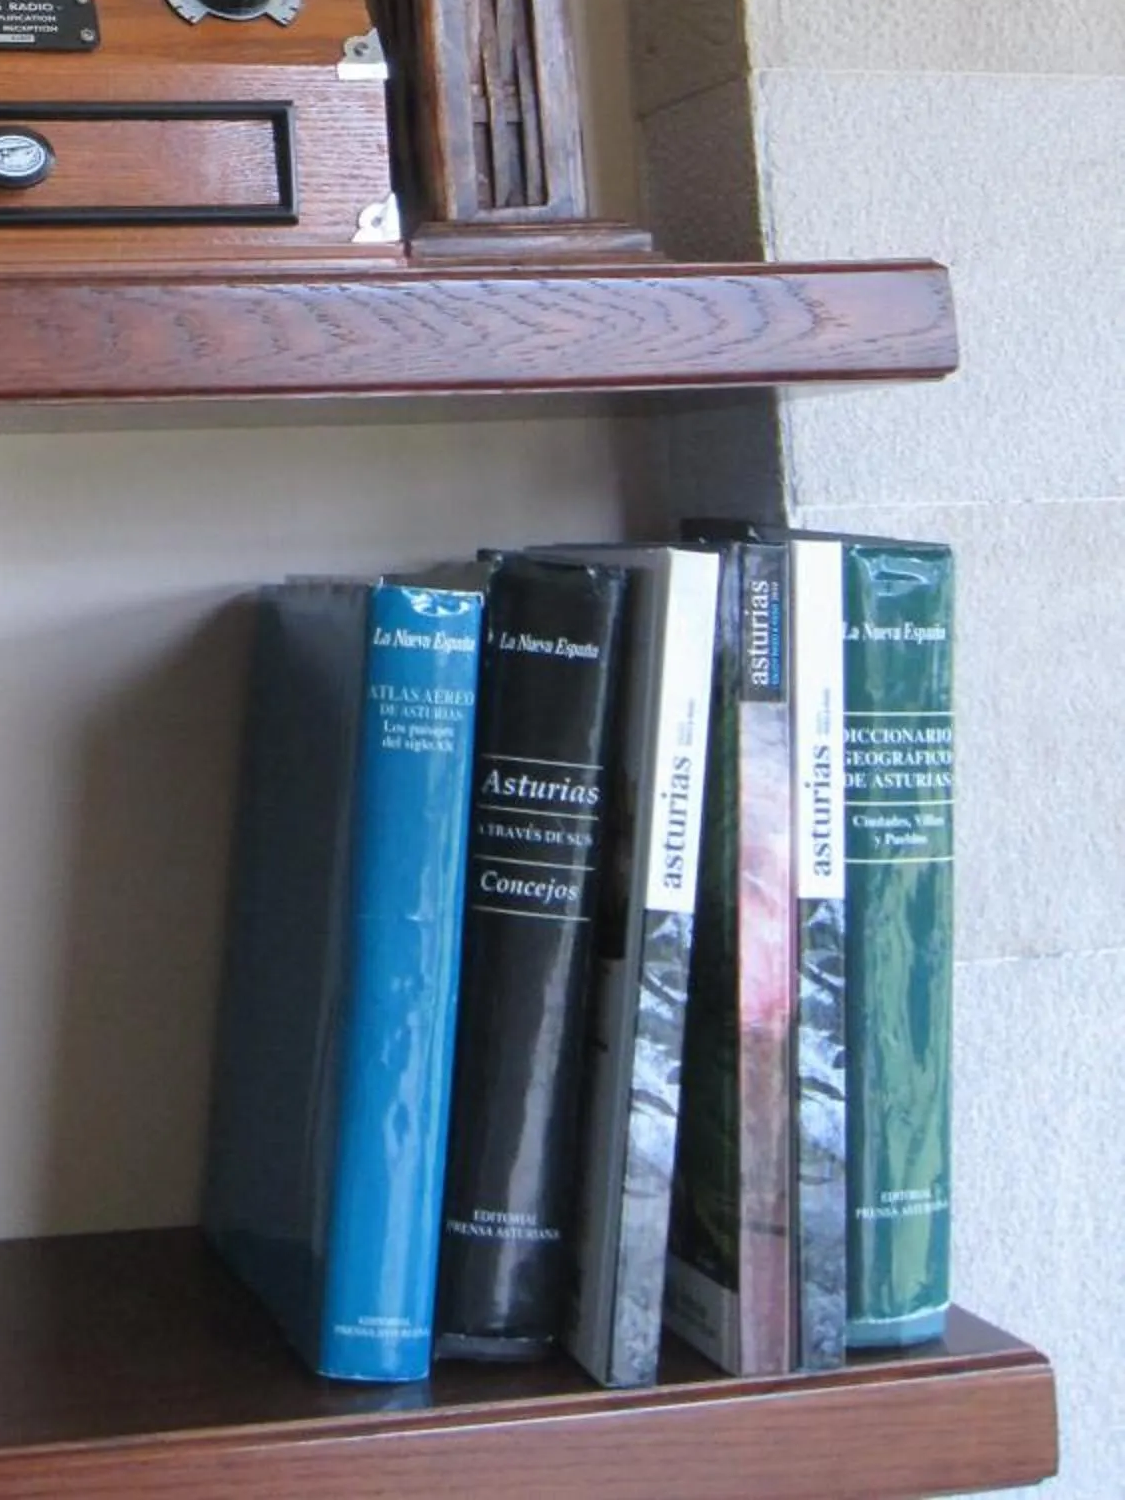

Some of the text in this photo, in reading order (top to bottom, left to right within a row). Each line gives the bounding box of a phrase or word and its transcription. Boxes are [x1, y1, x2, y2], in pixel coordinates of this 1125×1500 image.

[8, 2, 55, 11] RADIO
[373, 627, 476, 655] La Nueva España
[498, 631, 600, 659] La Nueva España
[744, 580, 770, 686] asturias
[843, 621, 946, 645] La Nueva España
[368, 684, 421, 702] ATLAS
[379, 703, 465, 721] DE ASTURIAS
[382, 735, 402, 750] del
[481, 768, 601, 806] Asturias
[843, 771, 952, 789] DE ASTURIAS
[661, 755, 693, 890] asturias
[803, 744, 833, 878] asturias
[487, 821, 543, 844] TRAVÉS
[544, 829, 565, 844] DE
[565, 831, 594, 847] SUS
[480, 869, 580, 905] Concejos
[473, 1209, 539, 1226] EDITORIAL
[495, 1225, 561, 1240] ASTURIANA
